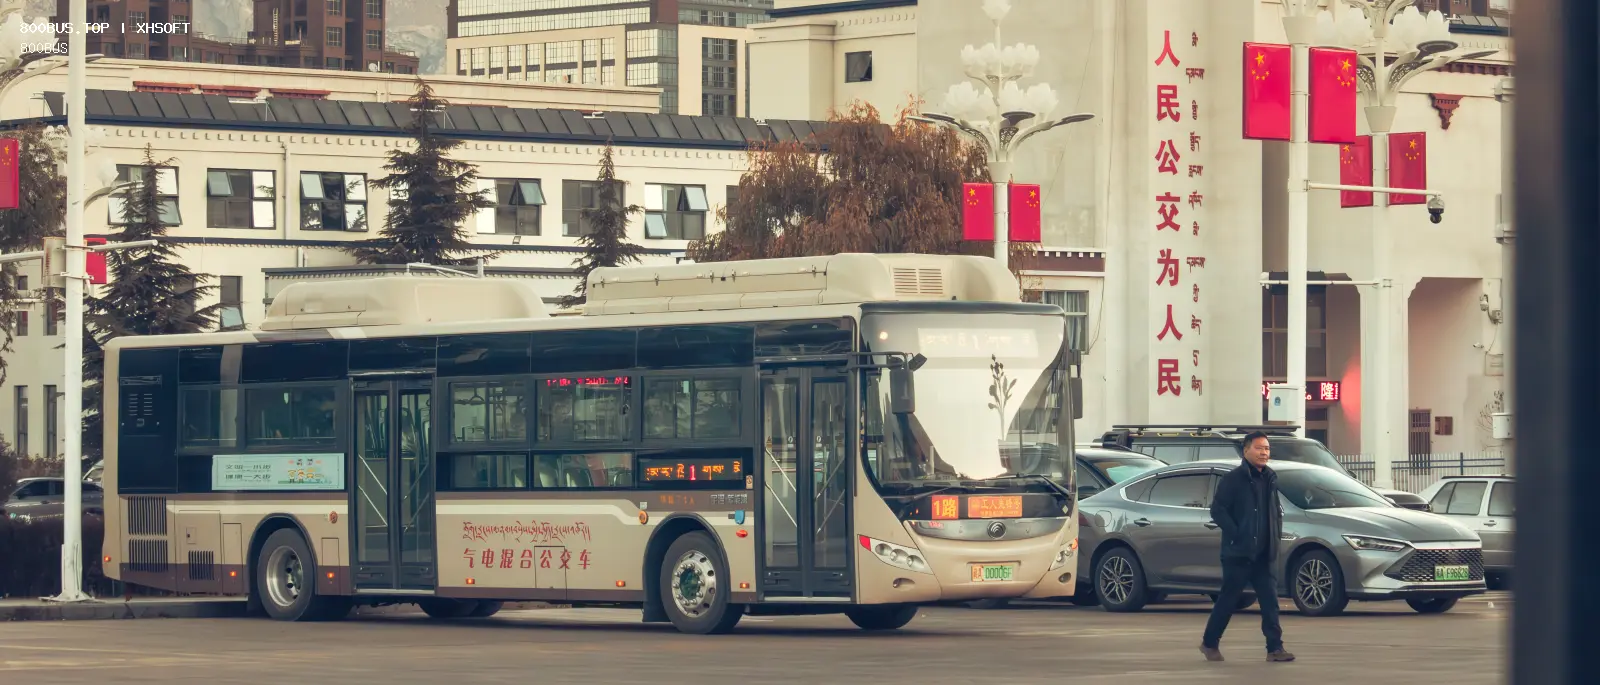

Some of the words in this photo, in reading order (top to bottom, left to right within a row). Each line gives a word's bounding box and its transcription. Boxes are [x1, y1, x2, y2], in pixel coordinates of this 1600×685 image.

[1154, 30, 1183, 397] 人民公交为人民
[933, 498, 957, 518] 1路
[463, 548, 592, 570] 气电混合公交车
